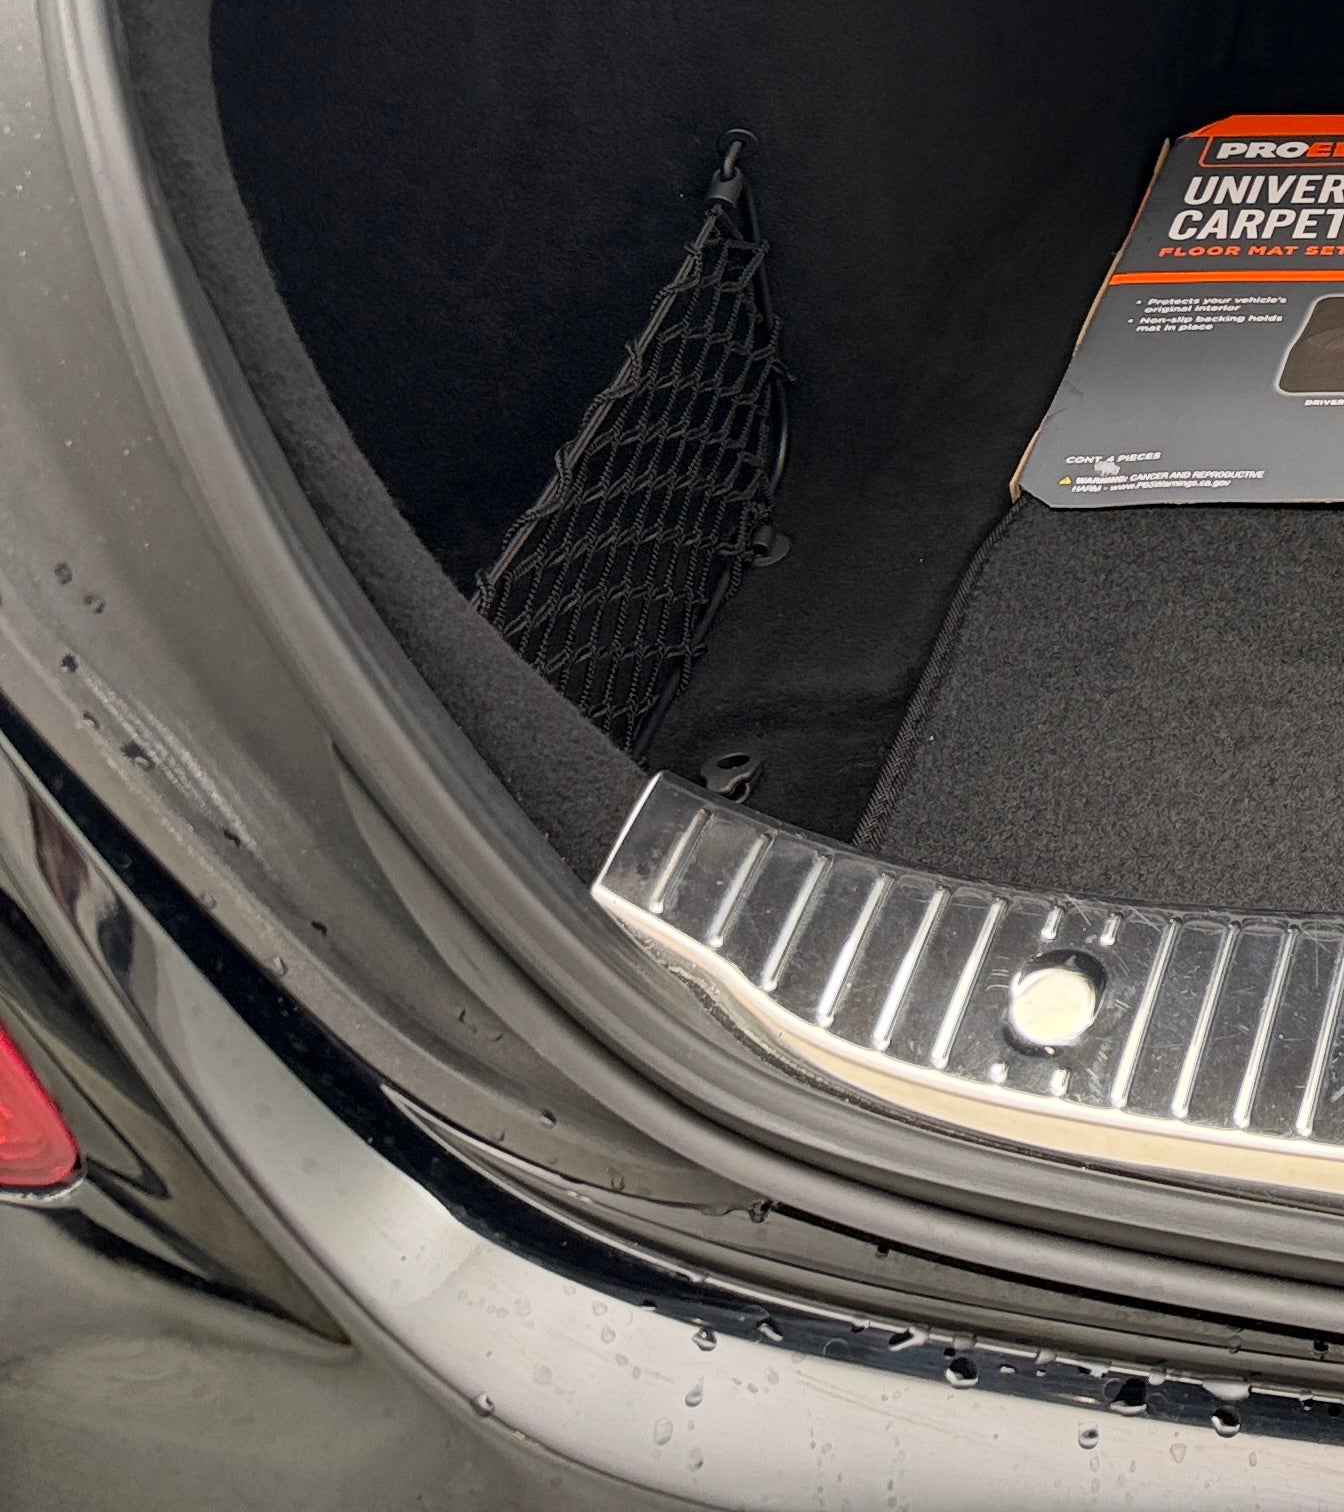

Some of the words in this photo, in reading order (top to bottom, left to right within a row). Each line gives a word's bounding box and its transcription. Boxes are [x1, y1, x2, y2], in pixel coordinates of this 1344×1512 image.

[1158, 246, 1241, 257] FLOOR
[1248, 246, 1299, 256] MAT
[1202, 297, 1232, 305] your
[1234, 296, 1287, 304] vehicle's
[1144, 305, 1192, 314] original
[1140, 317, 1193, 325] Non-slip
[1195, 315, 1245, 323] backing
[1248, 314, 1282, 322] holds
[1178, 323, 1213, 331] place
[1117, 452, 1161, 462] PIECES
[1129, 472, 1168, 481] CANCER
[1169, 471, 1191, 479] AND
[1192, 470, 1264, 479] REPRODUCTIVE
[1072, 485, 1102, 493] HARM
